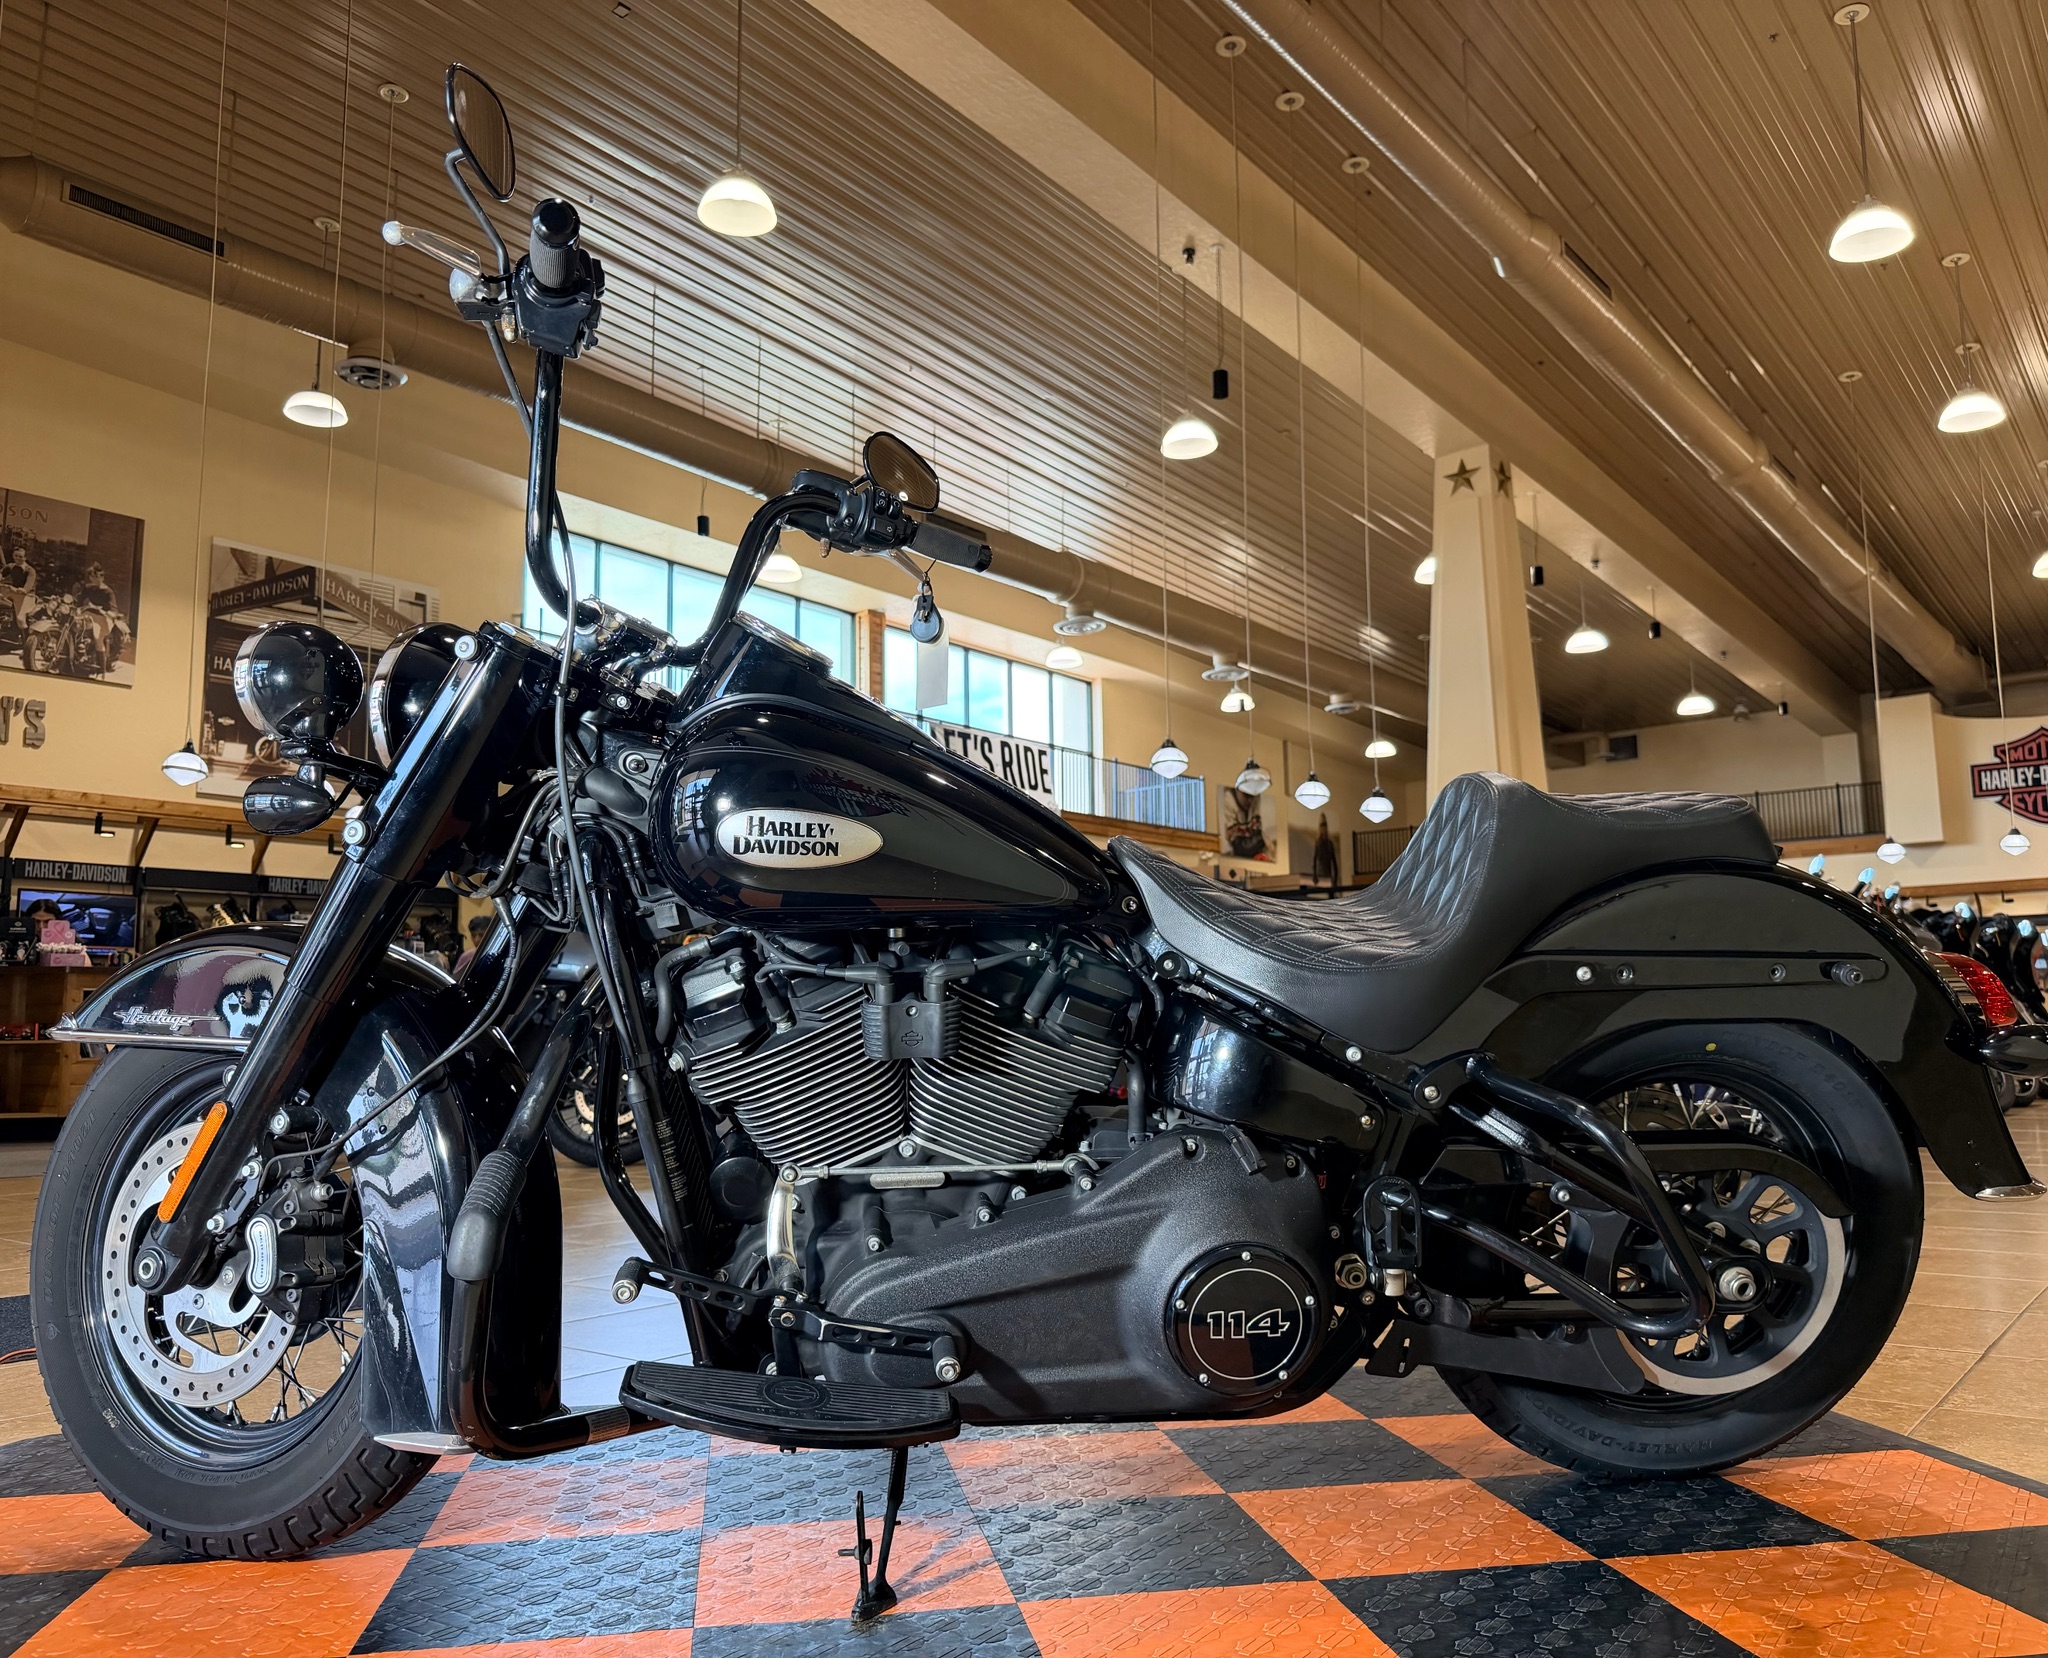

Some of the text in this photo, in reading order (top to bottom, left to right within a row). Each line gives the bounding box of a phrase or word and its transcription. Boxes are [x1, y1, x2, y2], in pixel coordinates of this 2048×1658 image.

[212, 574, 310, 609] HARLEY-DAVIDSON
[326, 578, 408, 632] HARLEY-DAV
[1000, 740, 1053, 794] RIDE
[733, 834, 839, 857] DAVIDSON
[24, 861, 129, 884] HARLEY-DAVIDSON
[268, 877, 327, 895] HARLEY-DAV
[118, 1006, 197, 1031] Heritage
[43, 1192, 62, 1306] DUNLOP
[1207, 1308, 1290, 1339] 114
